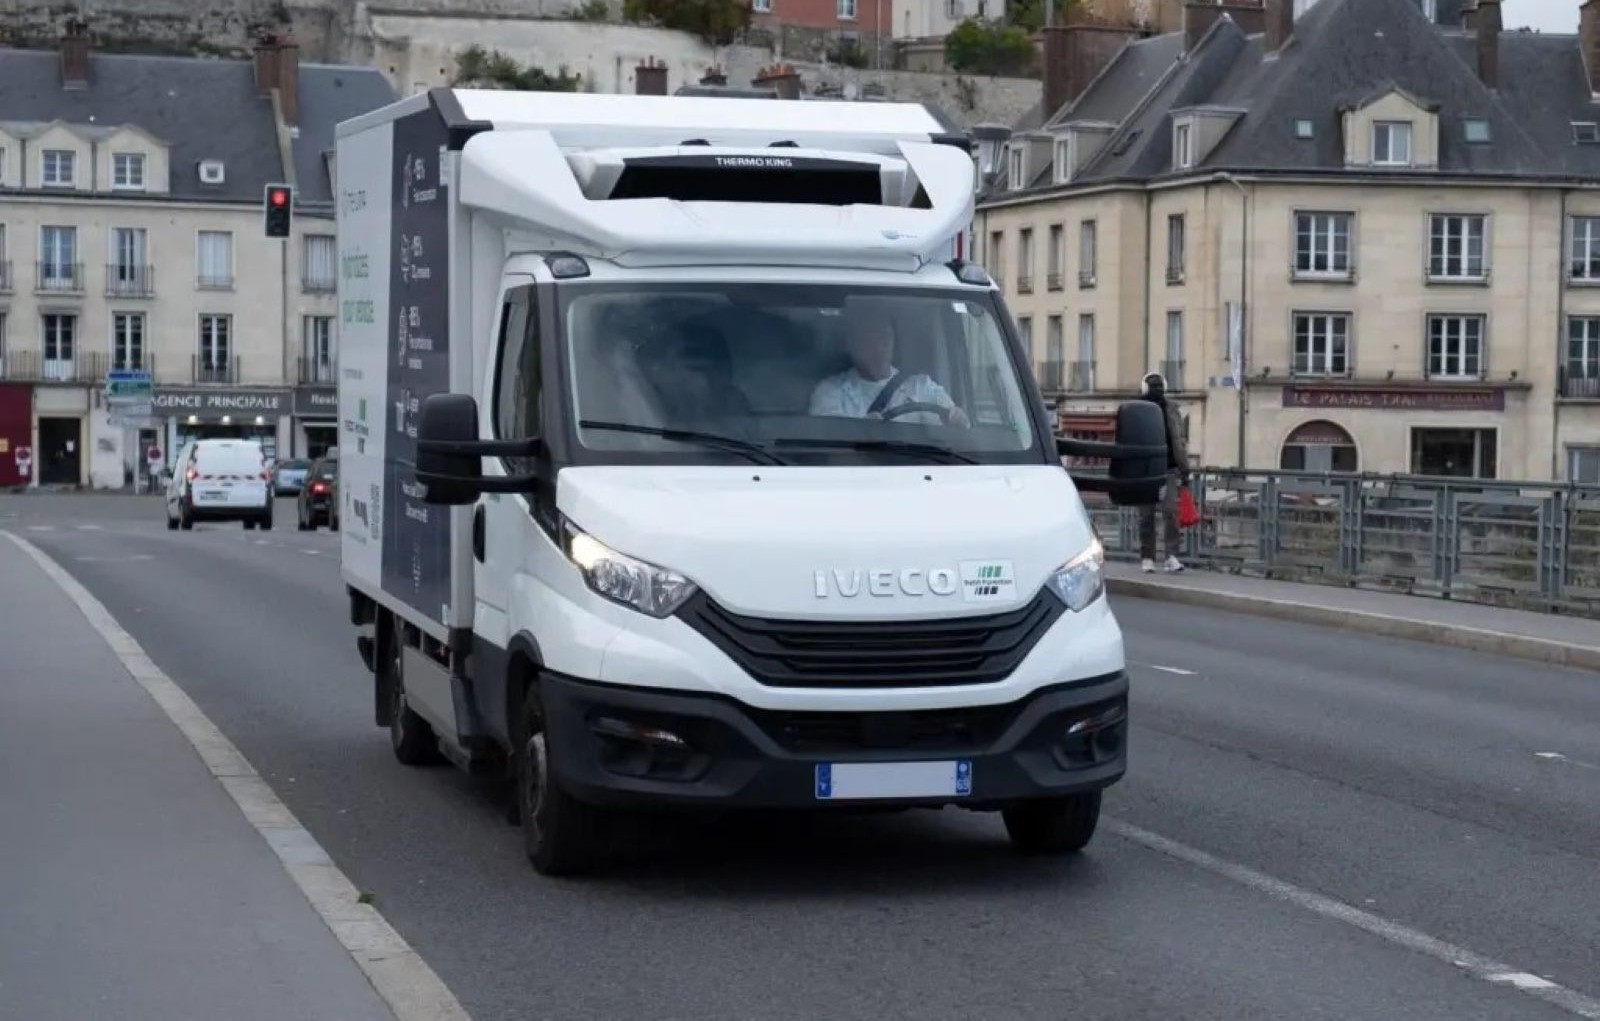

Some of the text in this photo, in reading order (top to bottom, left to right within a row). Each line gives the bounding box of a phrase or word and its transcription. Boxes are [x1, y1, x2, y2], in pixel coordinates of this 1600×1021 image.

[715, 157, 793, 168] THERMO KING
[207, 395, 279, 409] PRINCIPALE
[1319, 394, 1373, 406] PALAIS
[814, 568, 957, 598] IVECO
